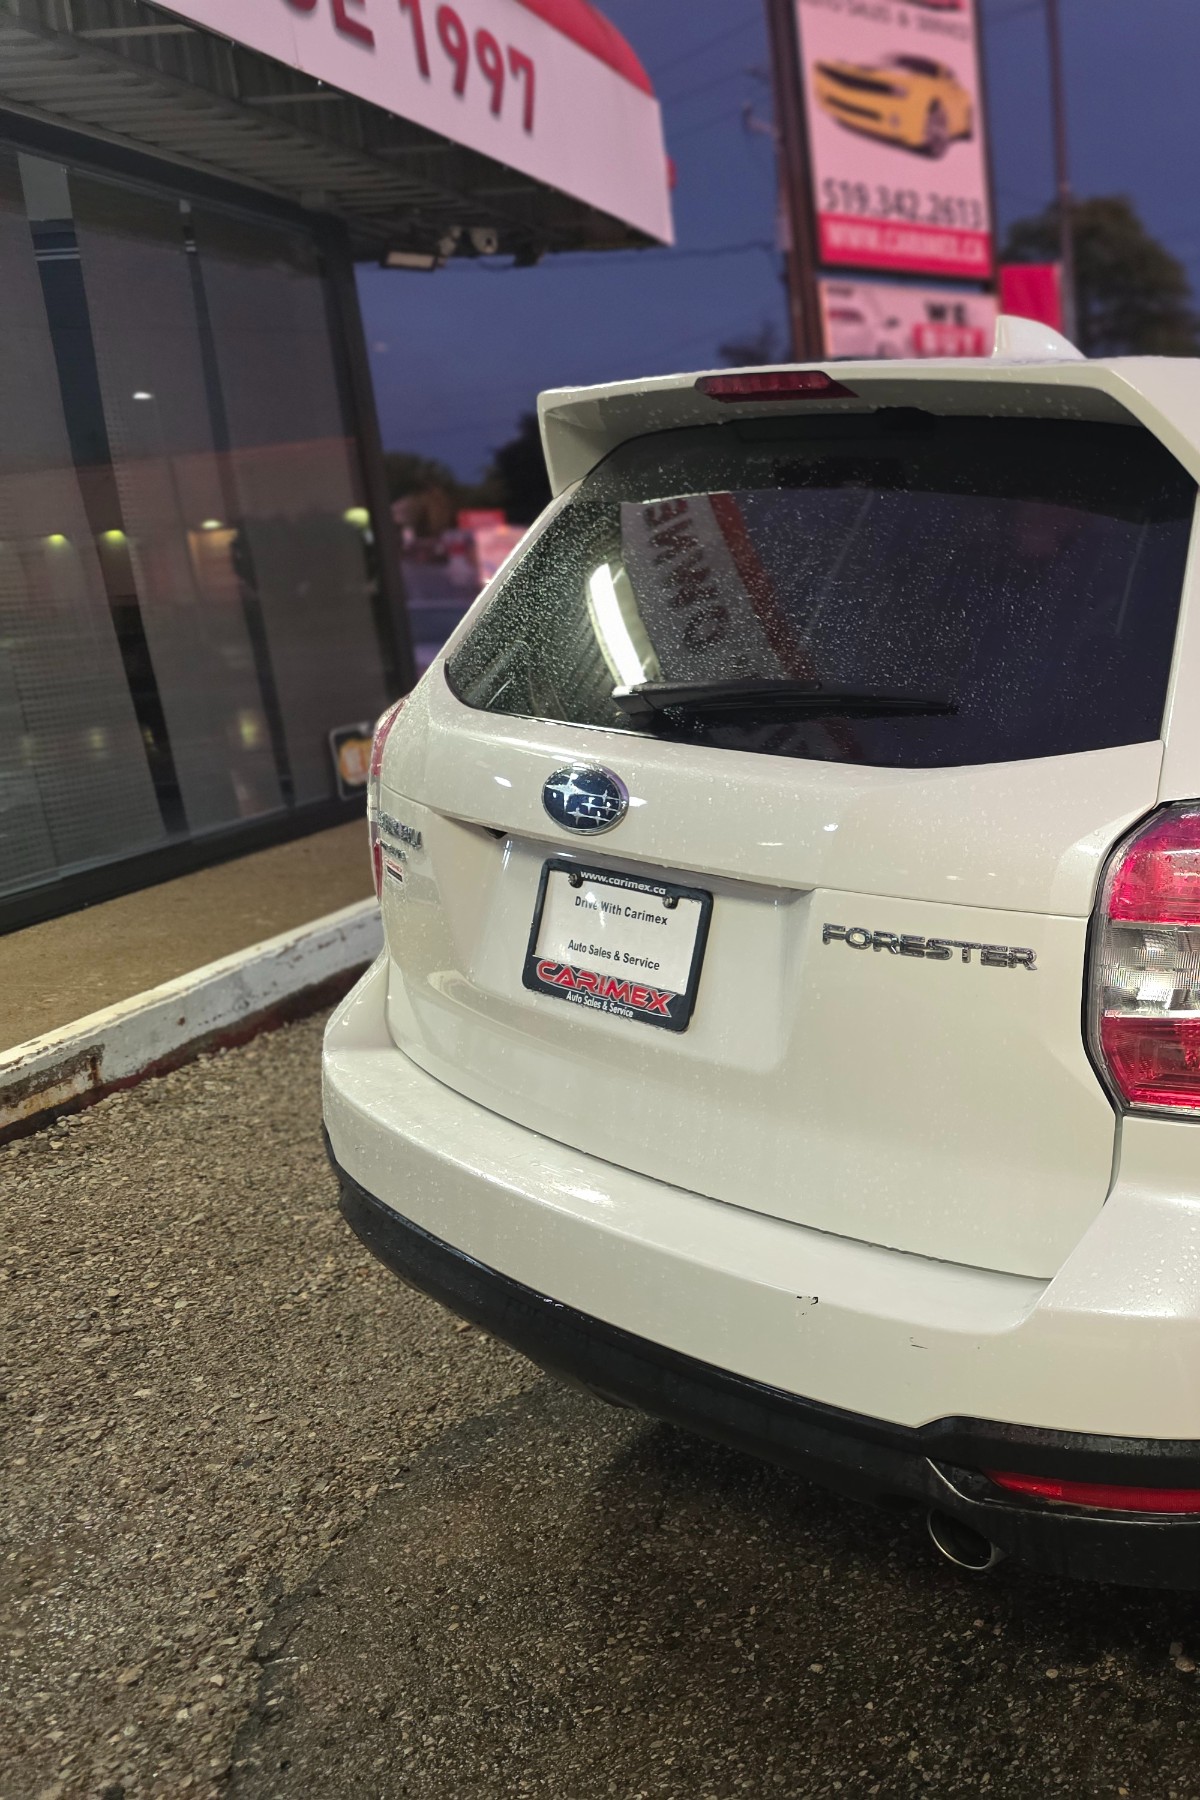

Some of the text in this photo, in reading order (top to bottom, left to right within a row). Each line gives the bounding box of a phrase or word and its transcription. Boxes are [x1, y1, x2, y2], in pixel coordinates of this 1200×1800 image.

[399, 0, 535, 136] 1997
[580, 870, 667, 895] www.carimex.ca
[574, 896, 668, 926] Drive With Carimex
[567, 939, 660, 971] Auto Sales & Service
[822, 922, 1038, 971] FORESTER
[536, 960, 676, 1018] CARIMEX
[566, 991, 634, 1019] Auto Sales & Service
